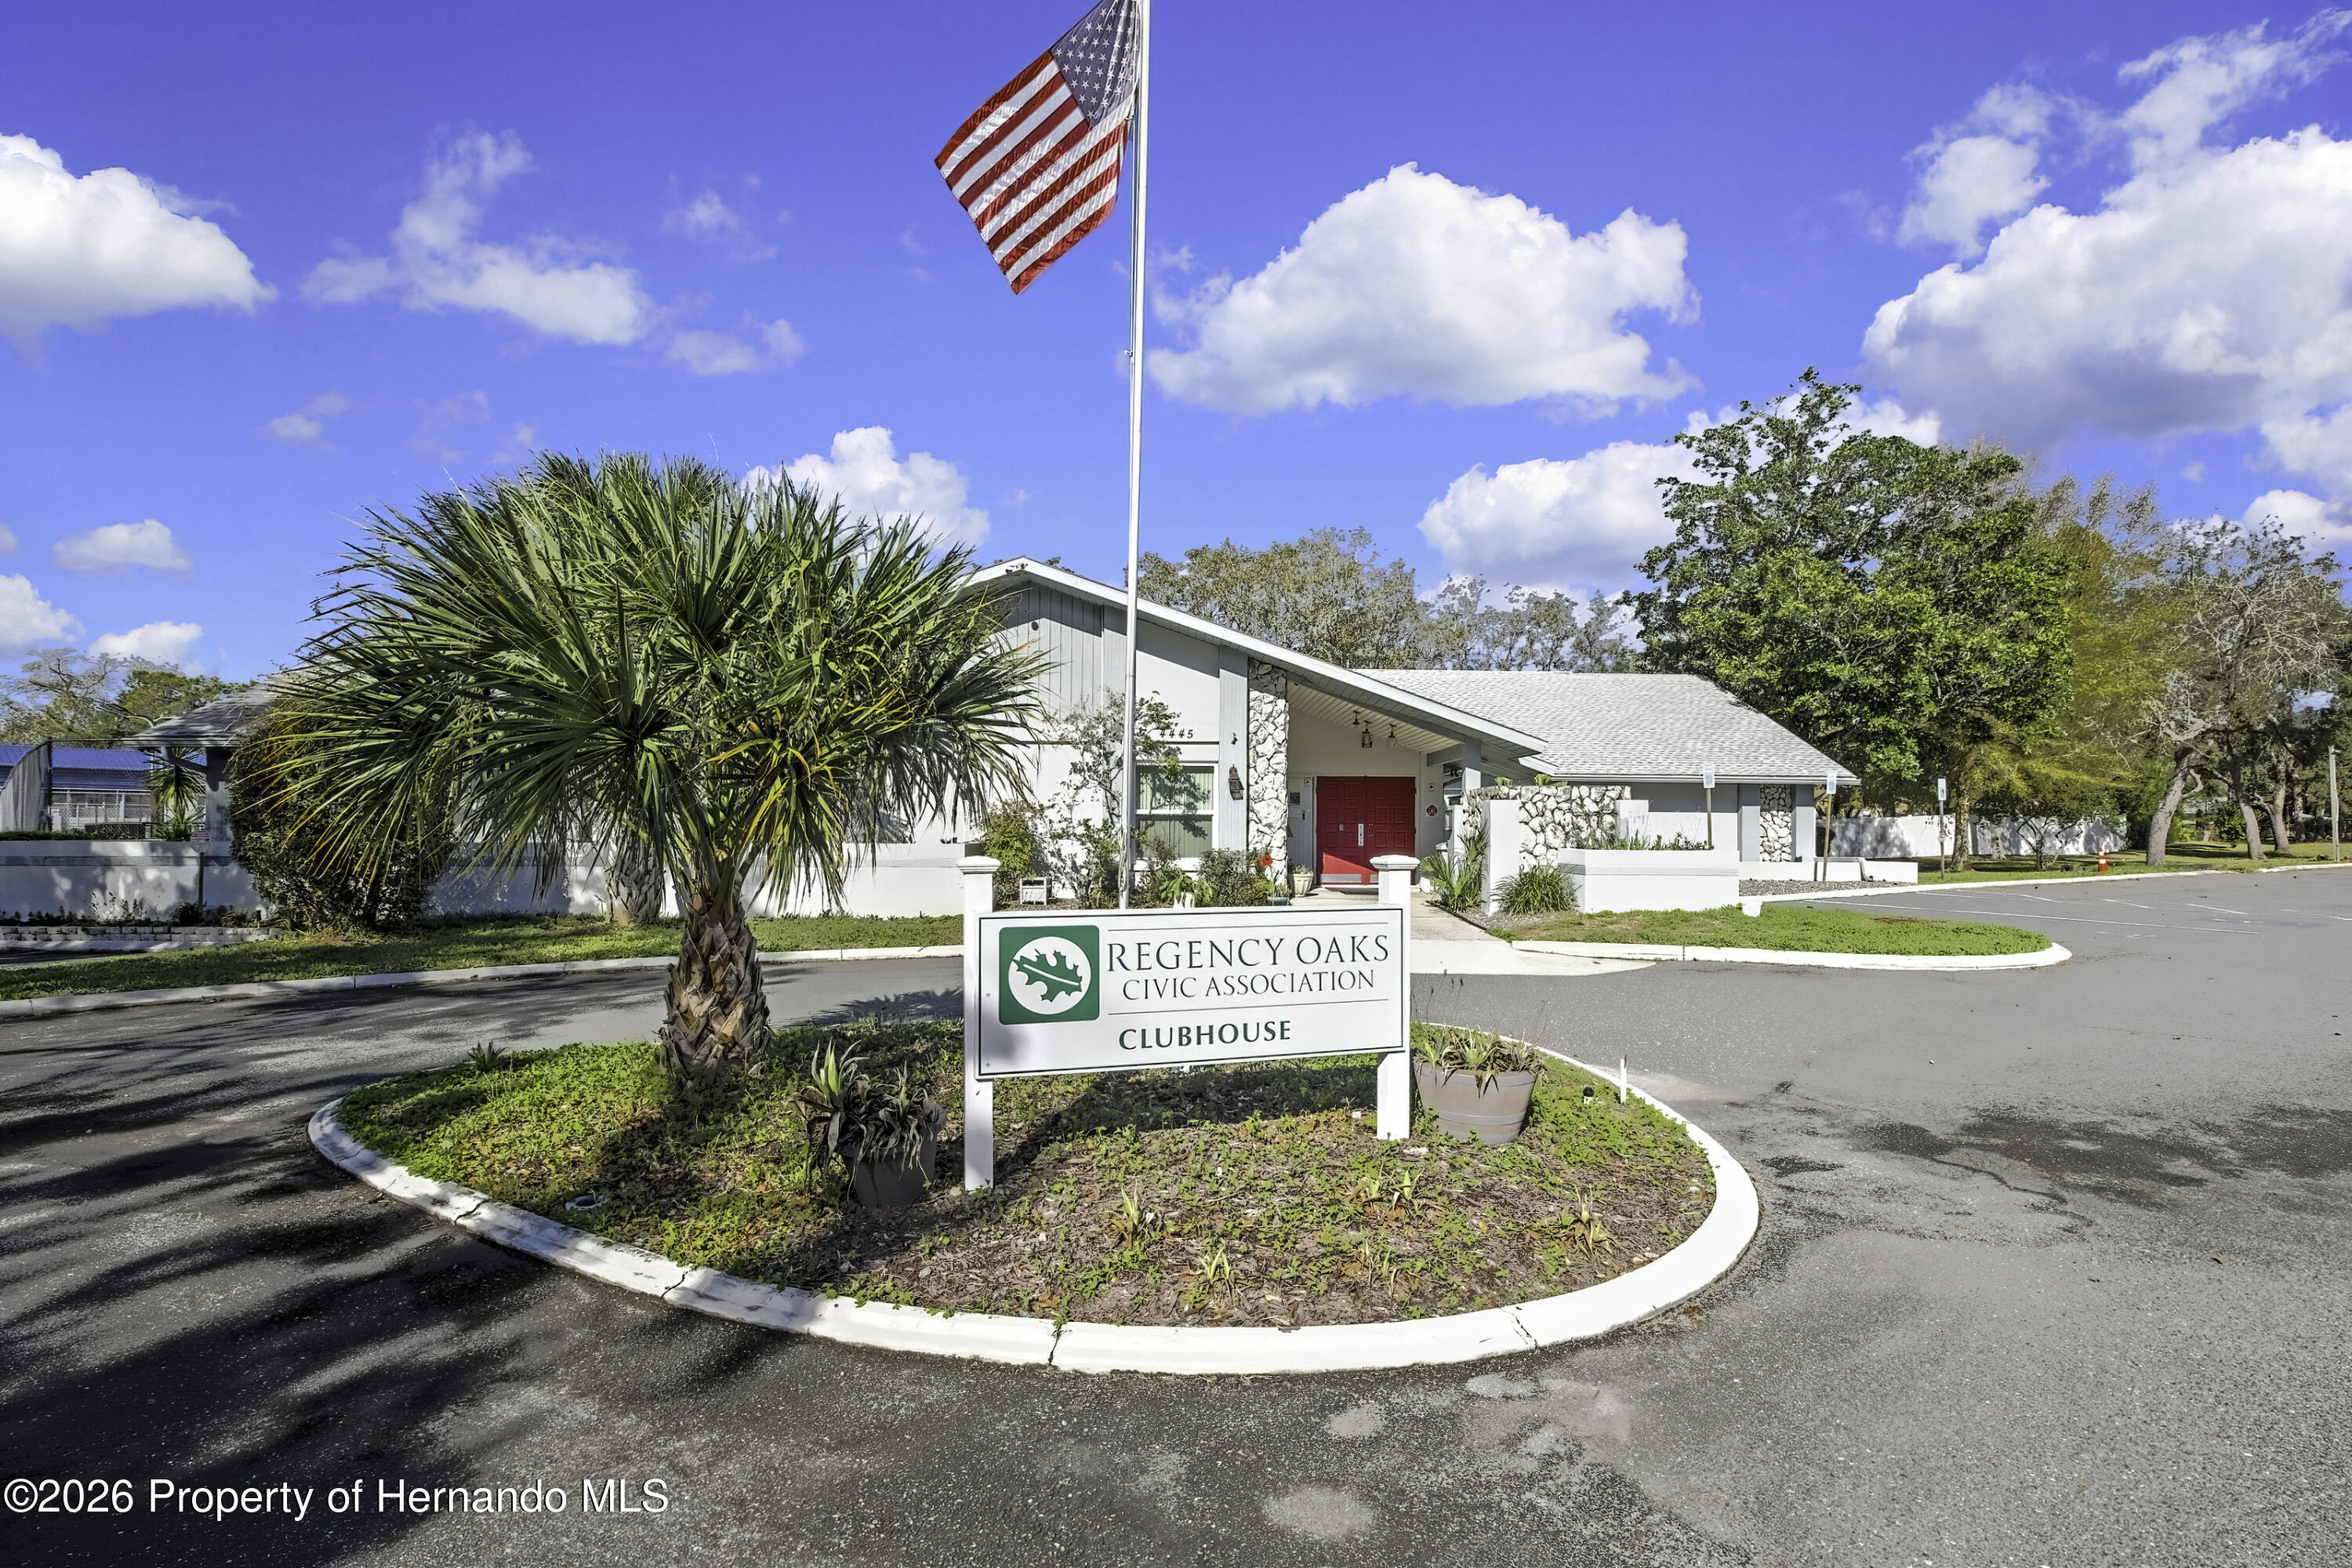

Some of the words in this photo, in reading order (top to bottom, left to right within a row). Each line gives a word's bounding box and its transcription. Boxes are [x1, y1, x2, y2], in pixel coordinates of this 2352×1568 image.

[1160, 728, 1193, 739] 4445
[1107, 938, 1285, 972] REGENCY
[1295, 934, 1390, 965] OAKS
[1122, 976, 1197, 1001] CIVIC
[1204, 969, 1375, 998] ASSOCIATION
[1118, 1020, 1291, 1051] CLUBHOUSE
